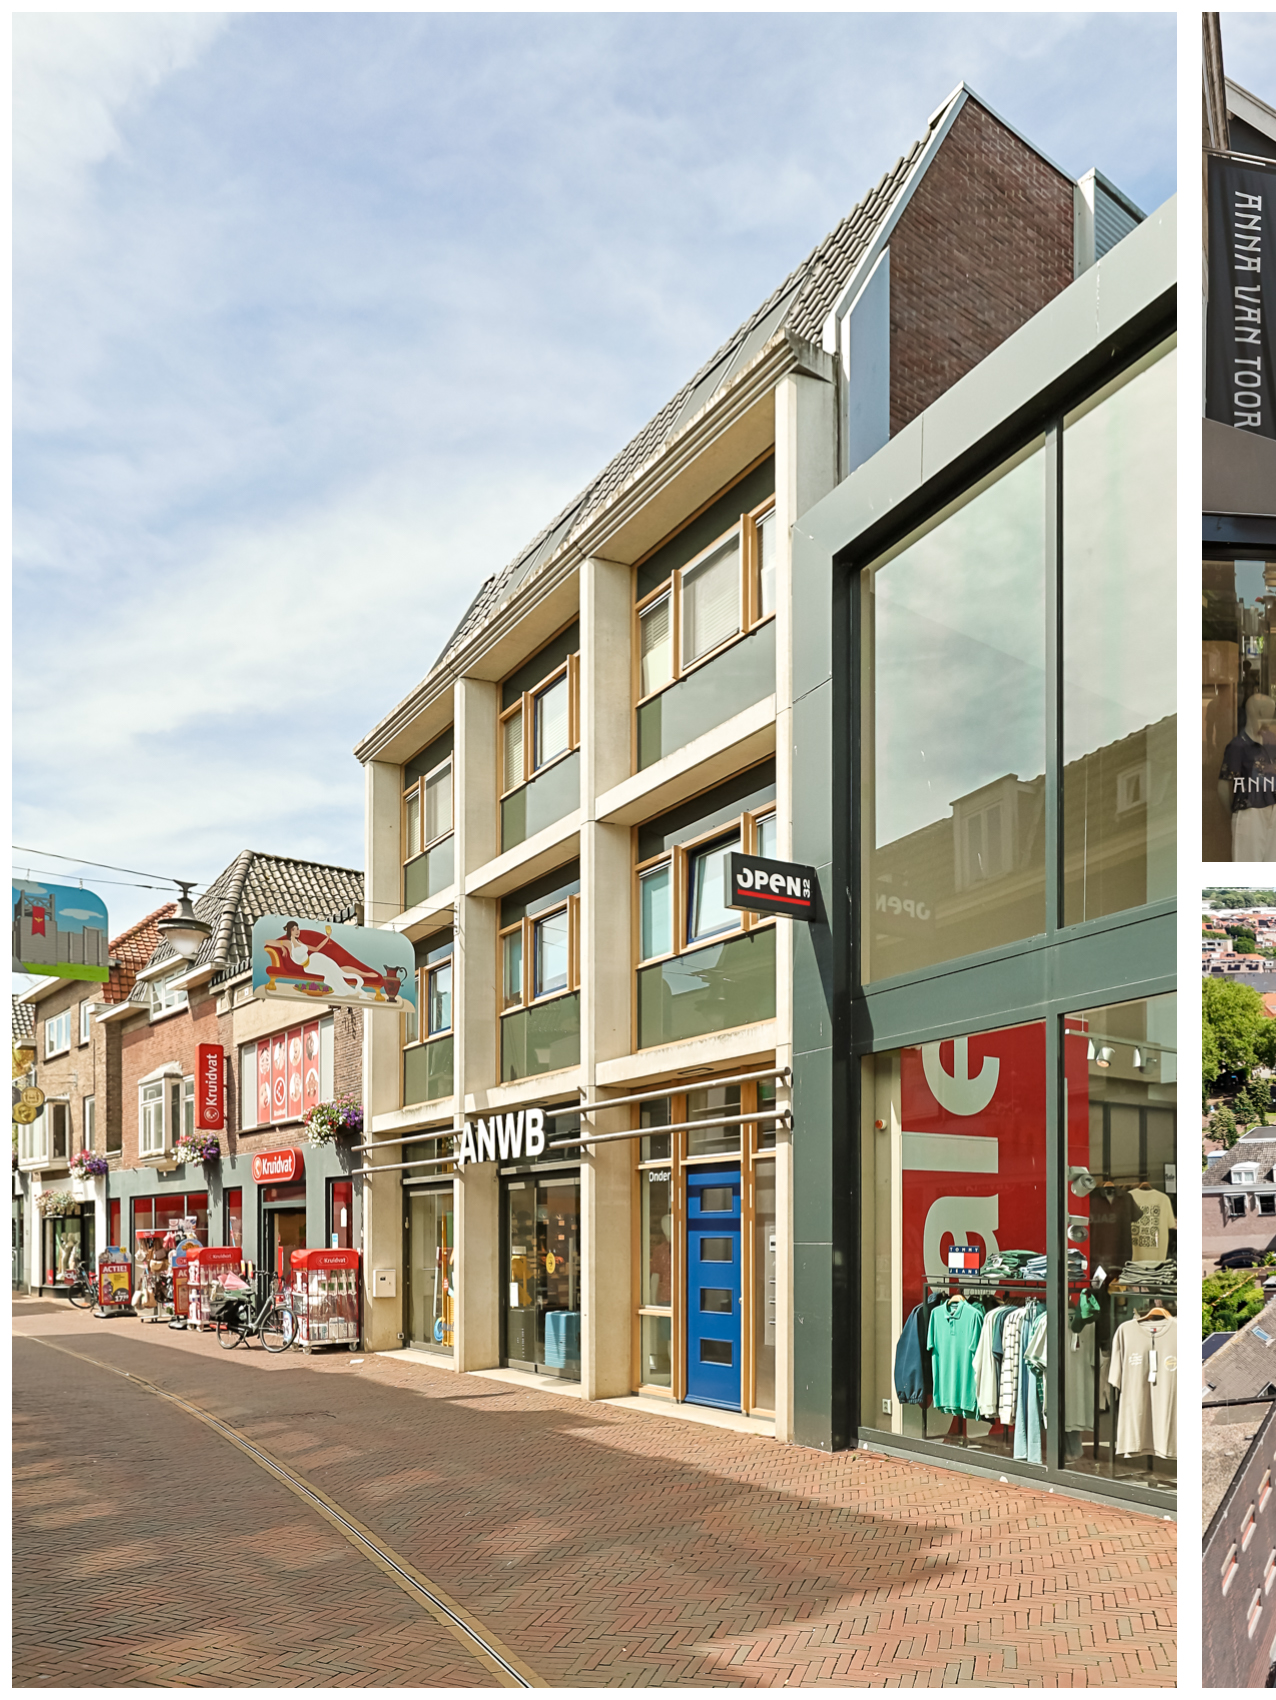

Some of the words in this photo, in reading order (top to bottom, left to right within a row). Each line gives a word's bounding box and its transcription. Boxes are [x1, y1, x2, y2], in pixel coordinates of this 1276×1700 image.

[1234, 191, 1262, 273] ANNA
[1234, 284, 1261, 345] VAN
[1233, 355, 1262, 428] TOOR
[802, 878, 811, 899] 32
[205, 1053, 218, 1106] Kruidvat
[458, 1107, 546, 1165] ANWB
[262, 1155, 292, 1175] Kruidvat
[648, 1171, 671, 1183] Onder
[102, 1265, 128, 1273] ACTIE!
[324, 1256, 346, 1264] Kruidvat
